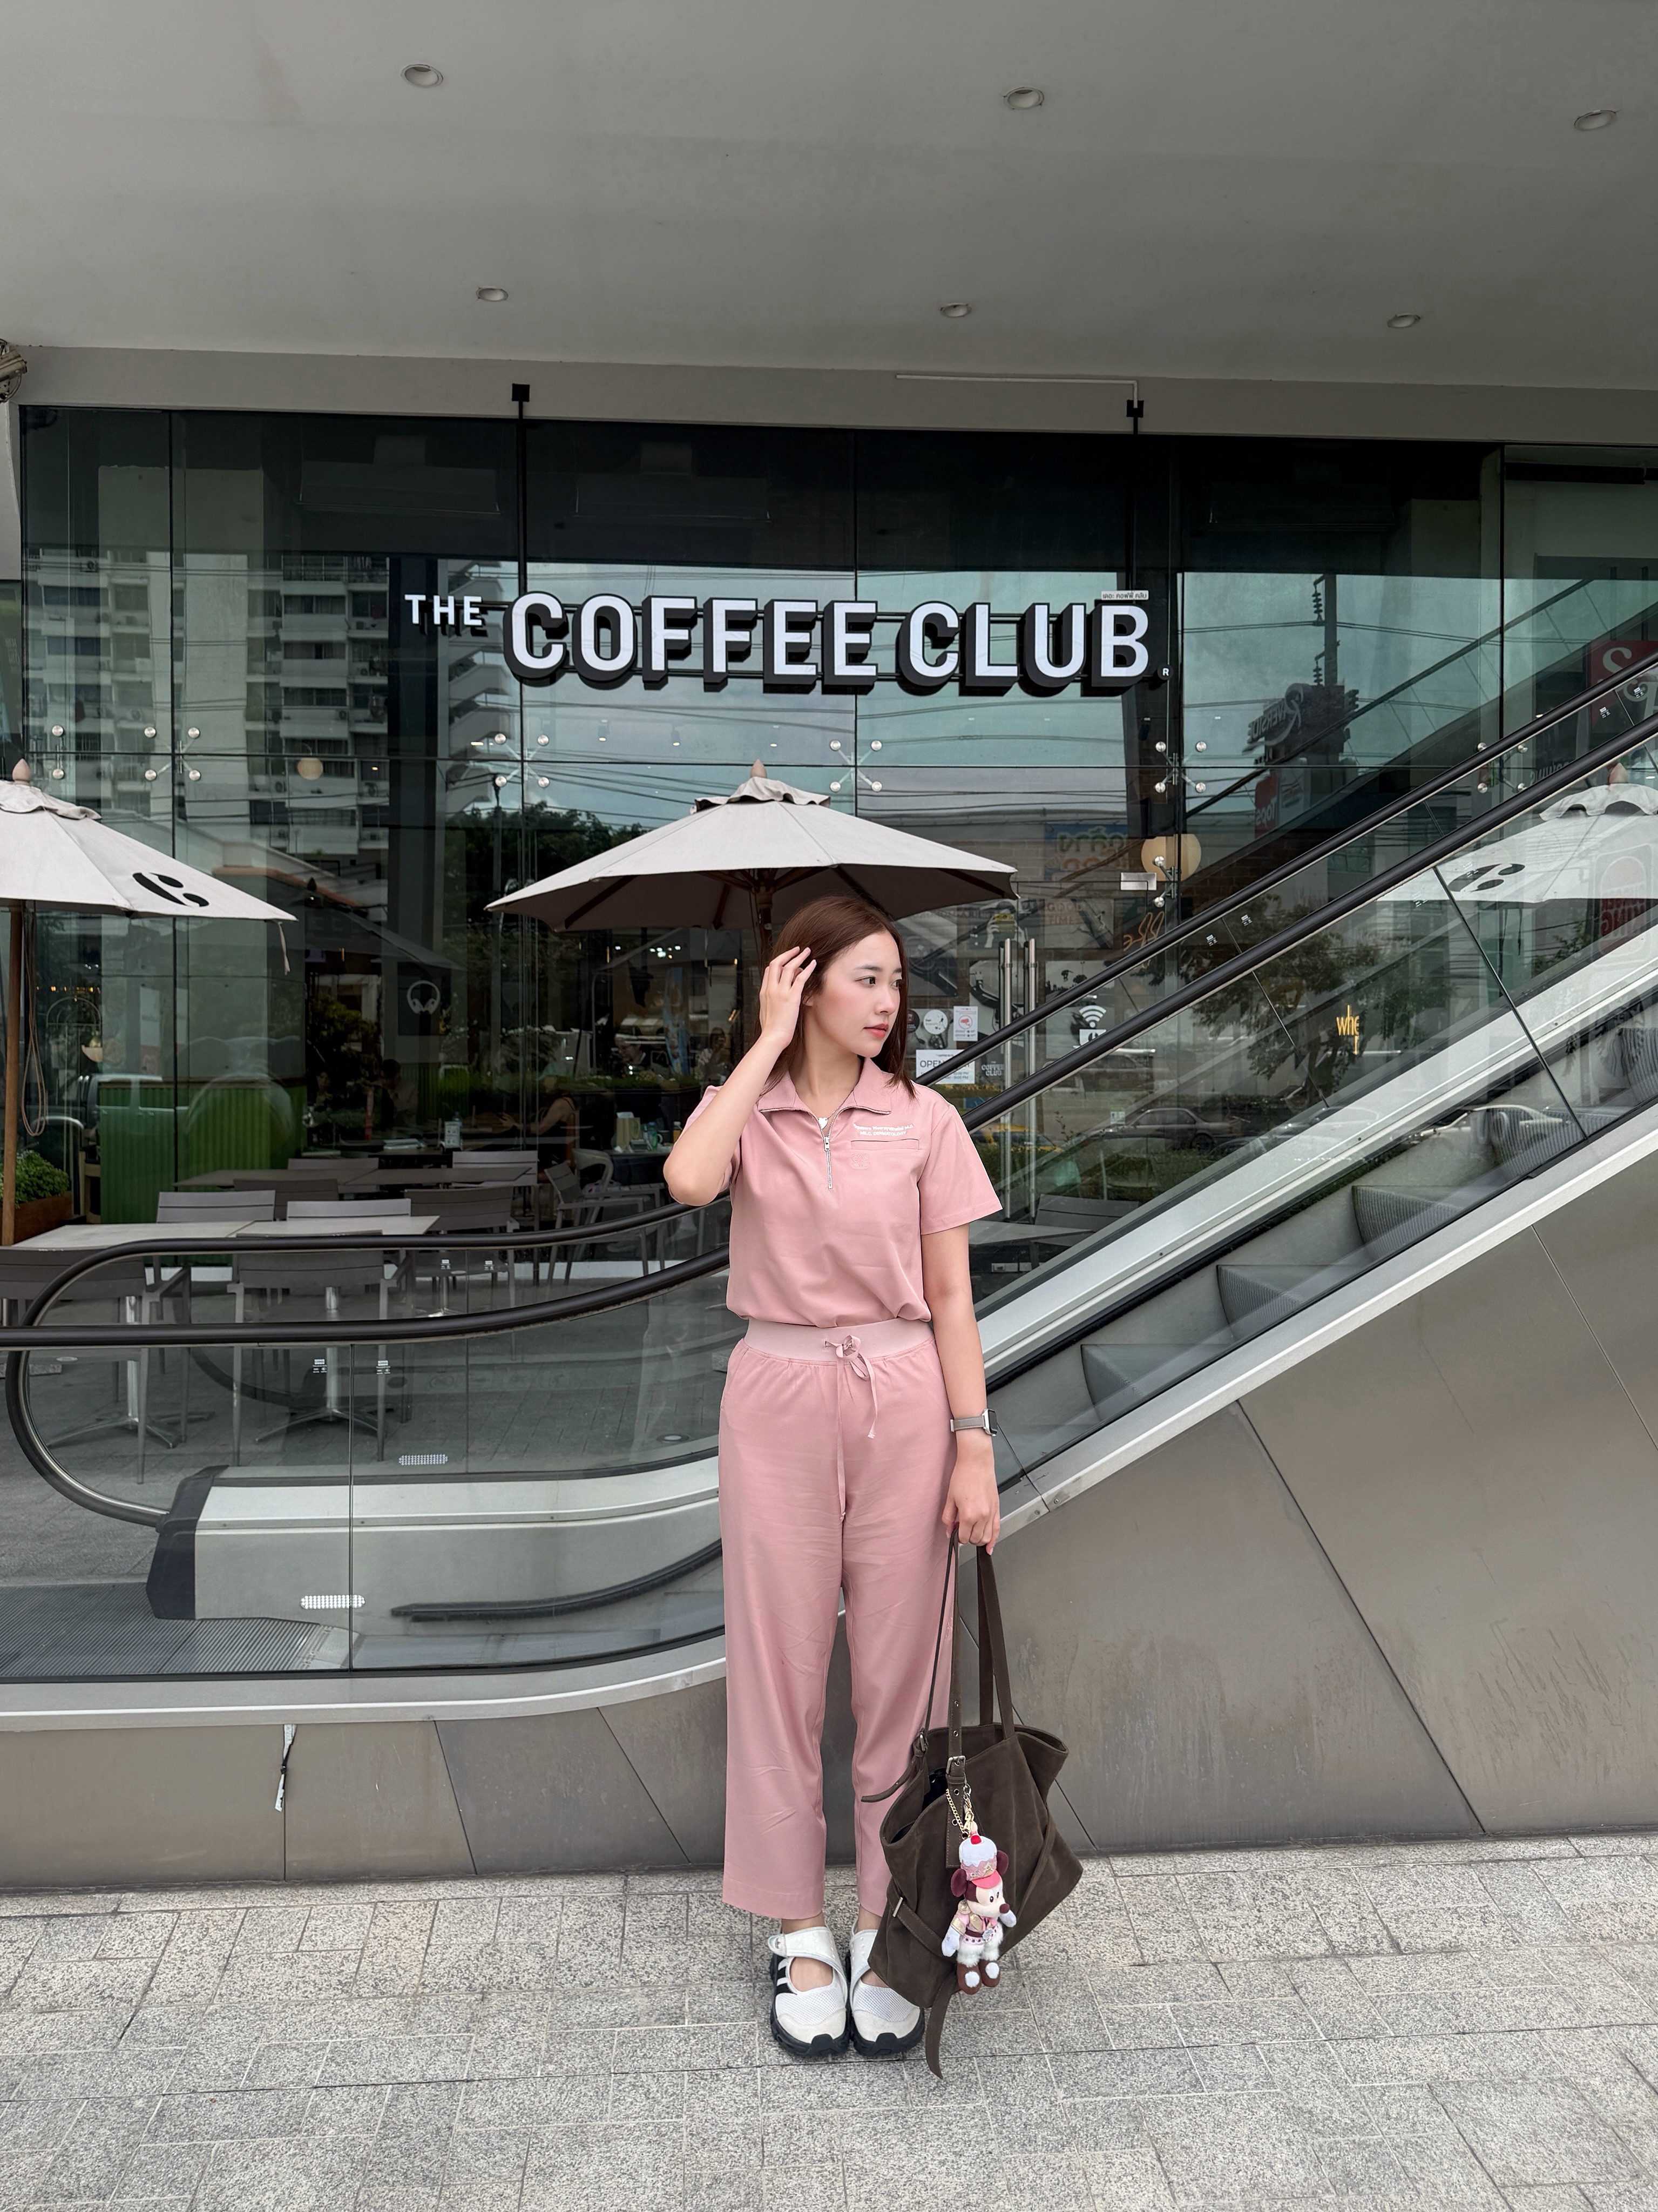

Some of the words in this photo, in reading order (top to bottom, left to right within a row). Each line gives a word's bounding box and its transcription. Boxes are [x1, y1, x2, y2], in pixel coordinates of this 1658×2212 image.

[404, 594, 482, 626] THE
[510, 592, 878, 678] COFFEE
[908, 601, 1149, 679] CLUB
